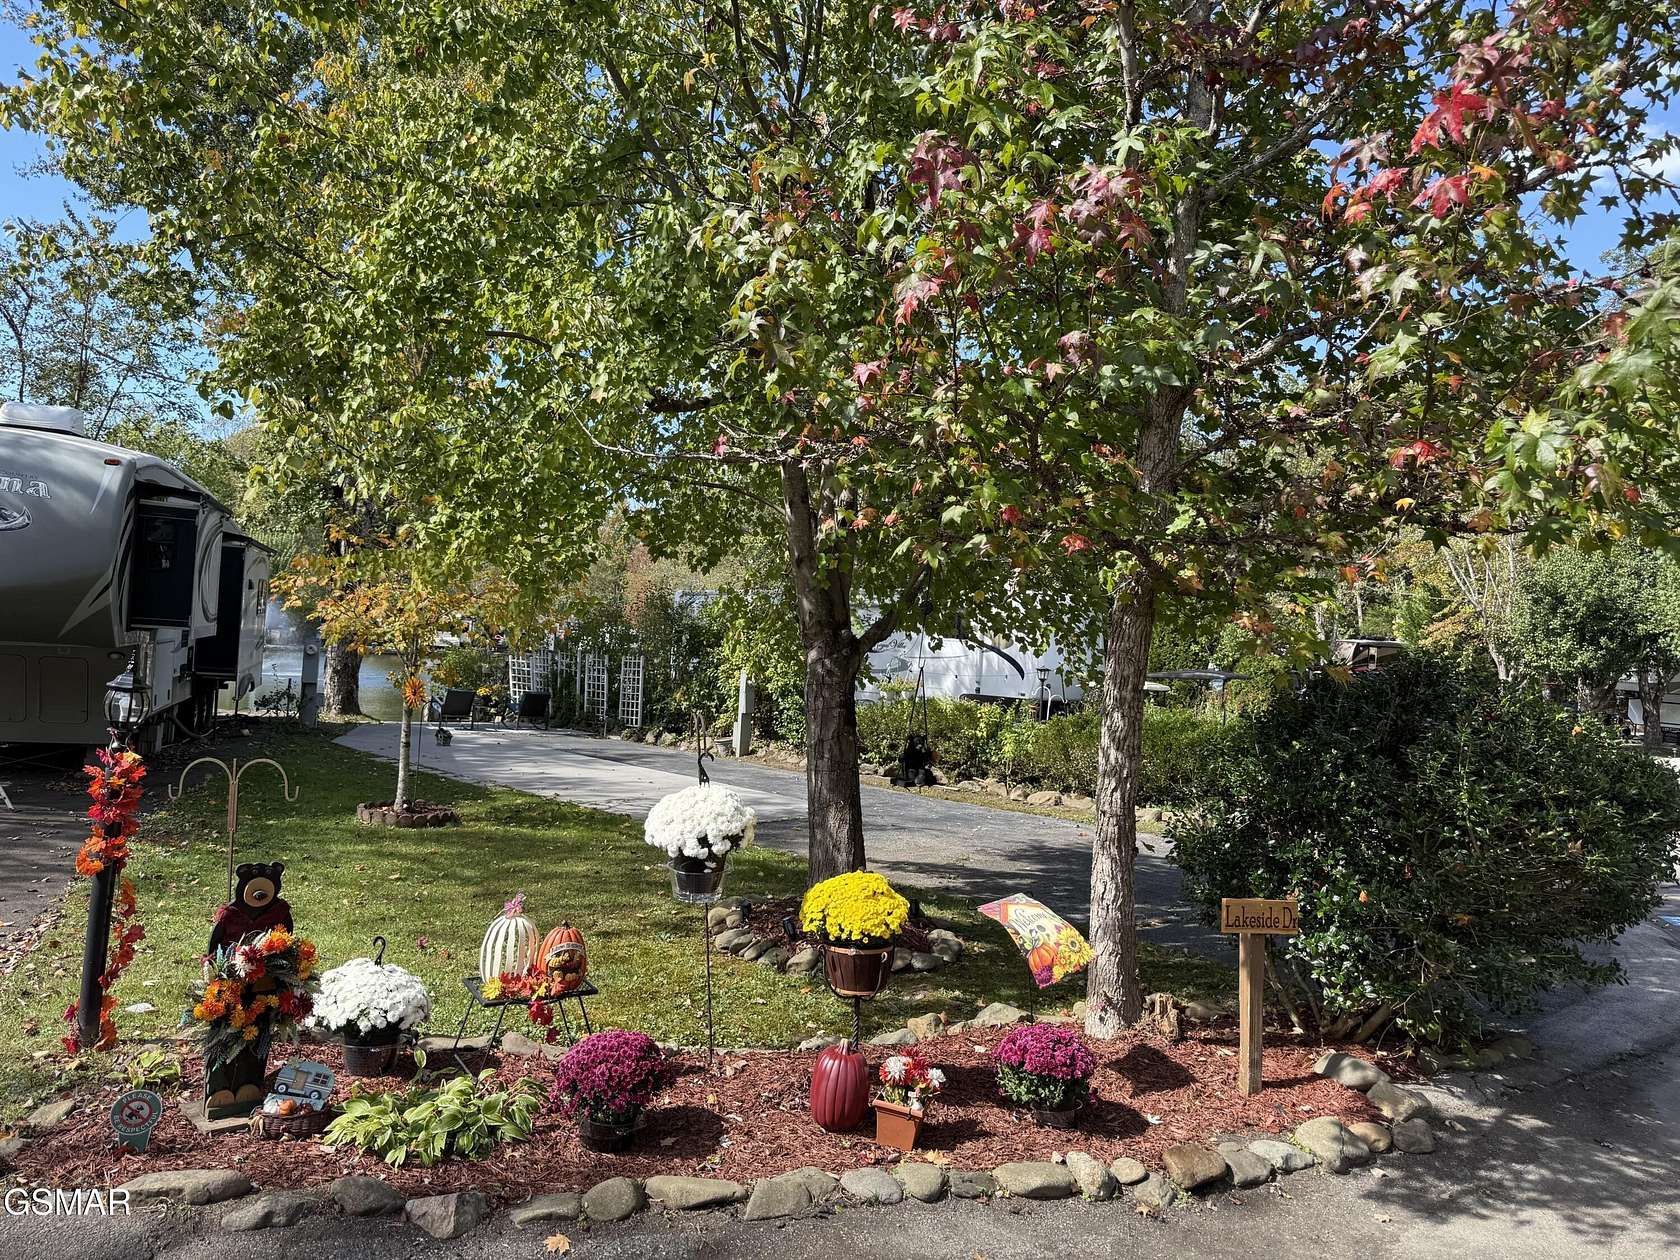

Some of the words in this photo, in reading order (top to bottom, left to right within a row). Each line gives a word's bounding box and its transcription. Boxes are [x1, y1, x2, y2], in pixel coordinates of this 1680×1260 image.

[1225, 904, 1280, 928] Lakeside
[1282, 906, 1298, 928] Dr
[122, 1092, 153, 1104] PLEASE
